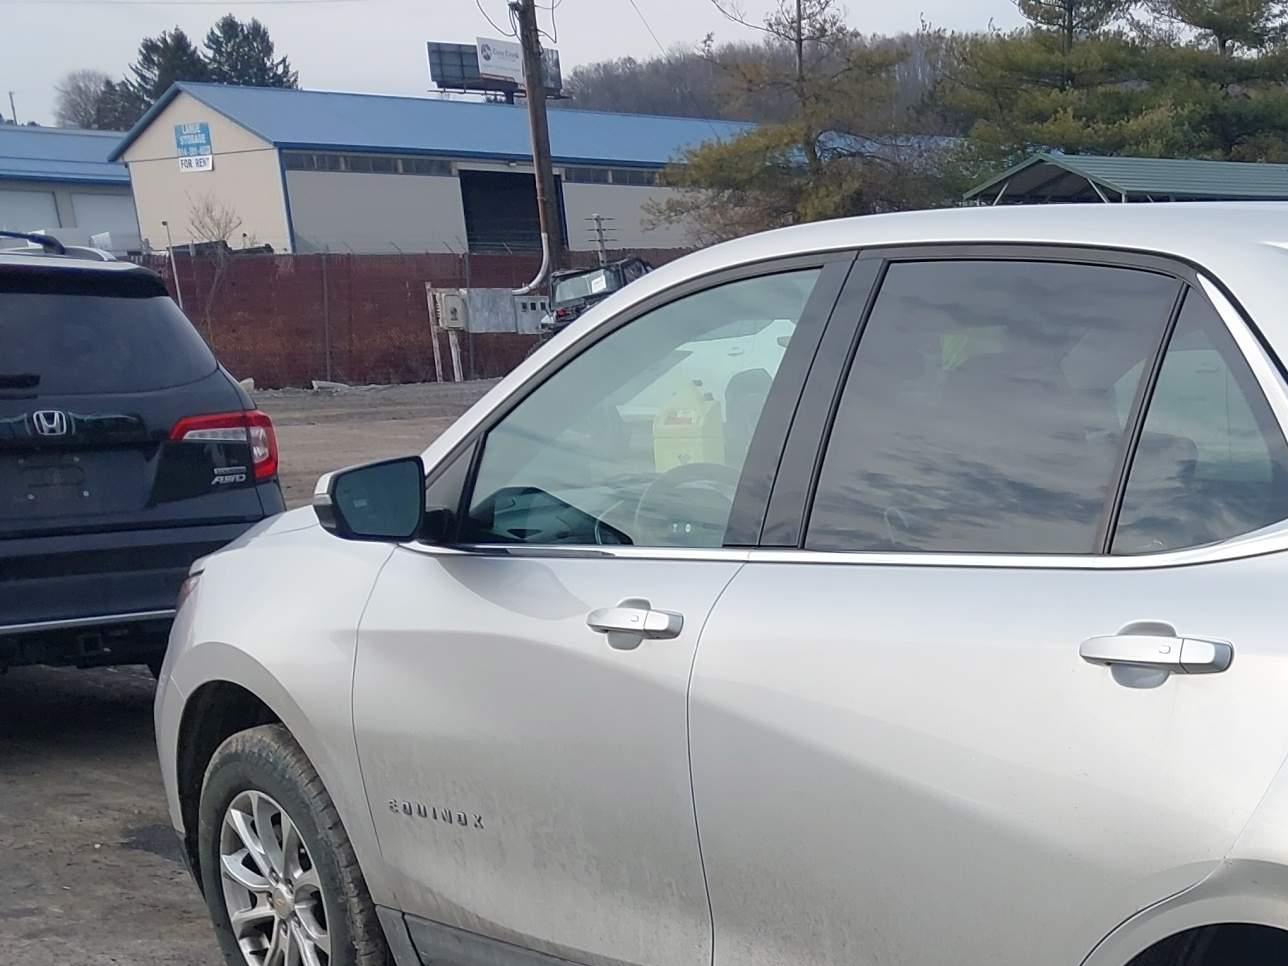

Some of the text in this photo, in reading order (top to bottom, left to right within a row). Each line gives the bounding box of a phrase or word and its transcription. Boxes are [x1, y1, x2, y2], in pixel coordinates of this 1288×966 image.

[180, 157, 209, 169] FOR RENT
[211, 474, 246, 485] AWD
[388, 799, 485, 829] EQUINOX
